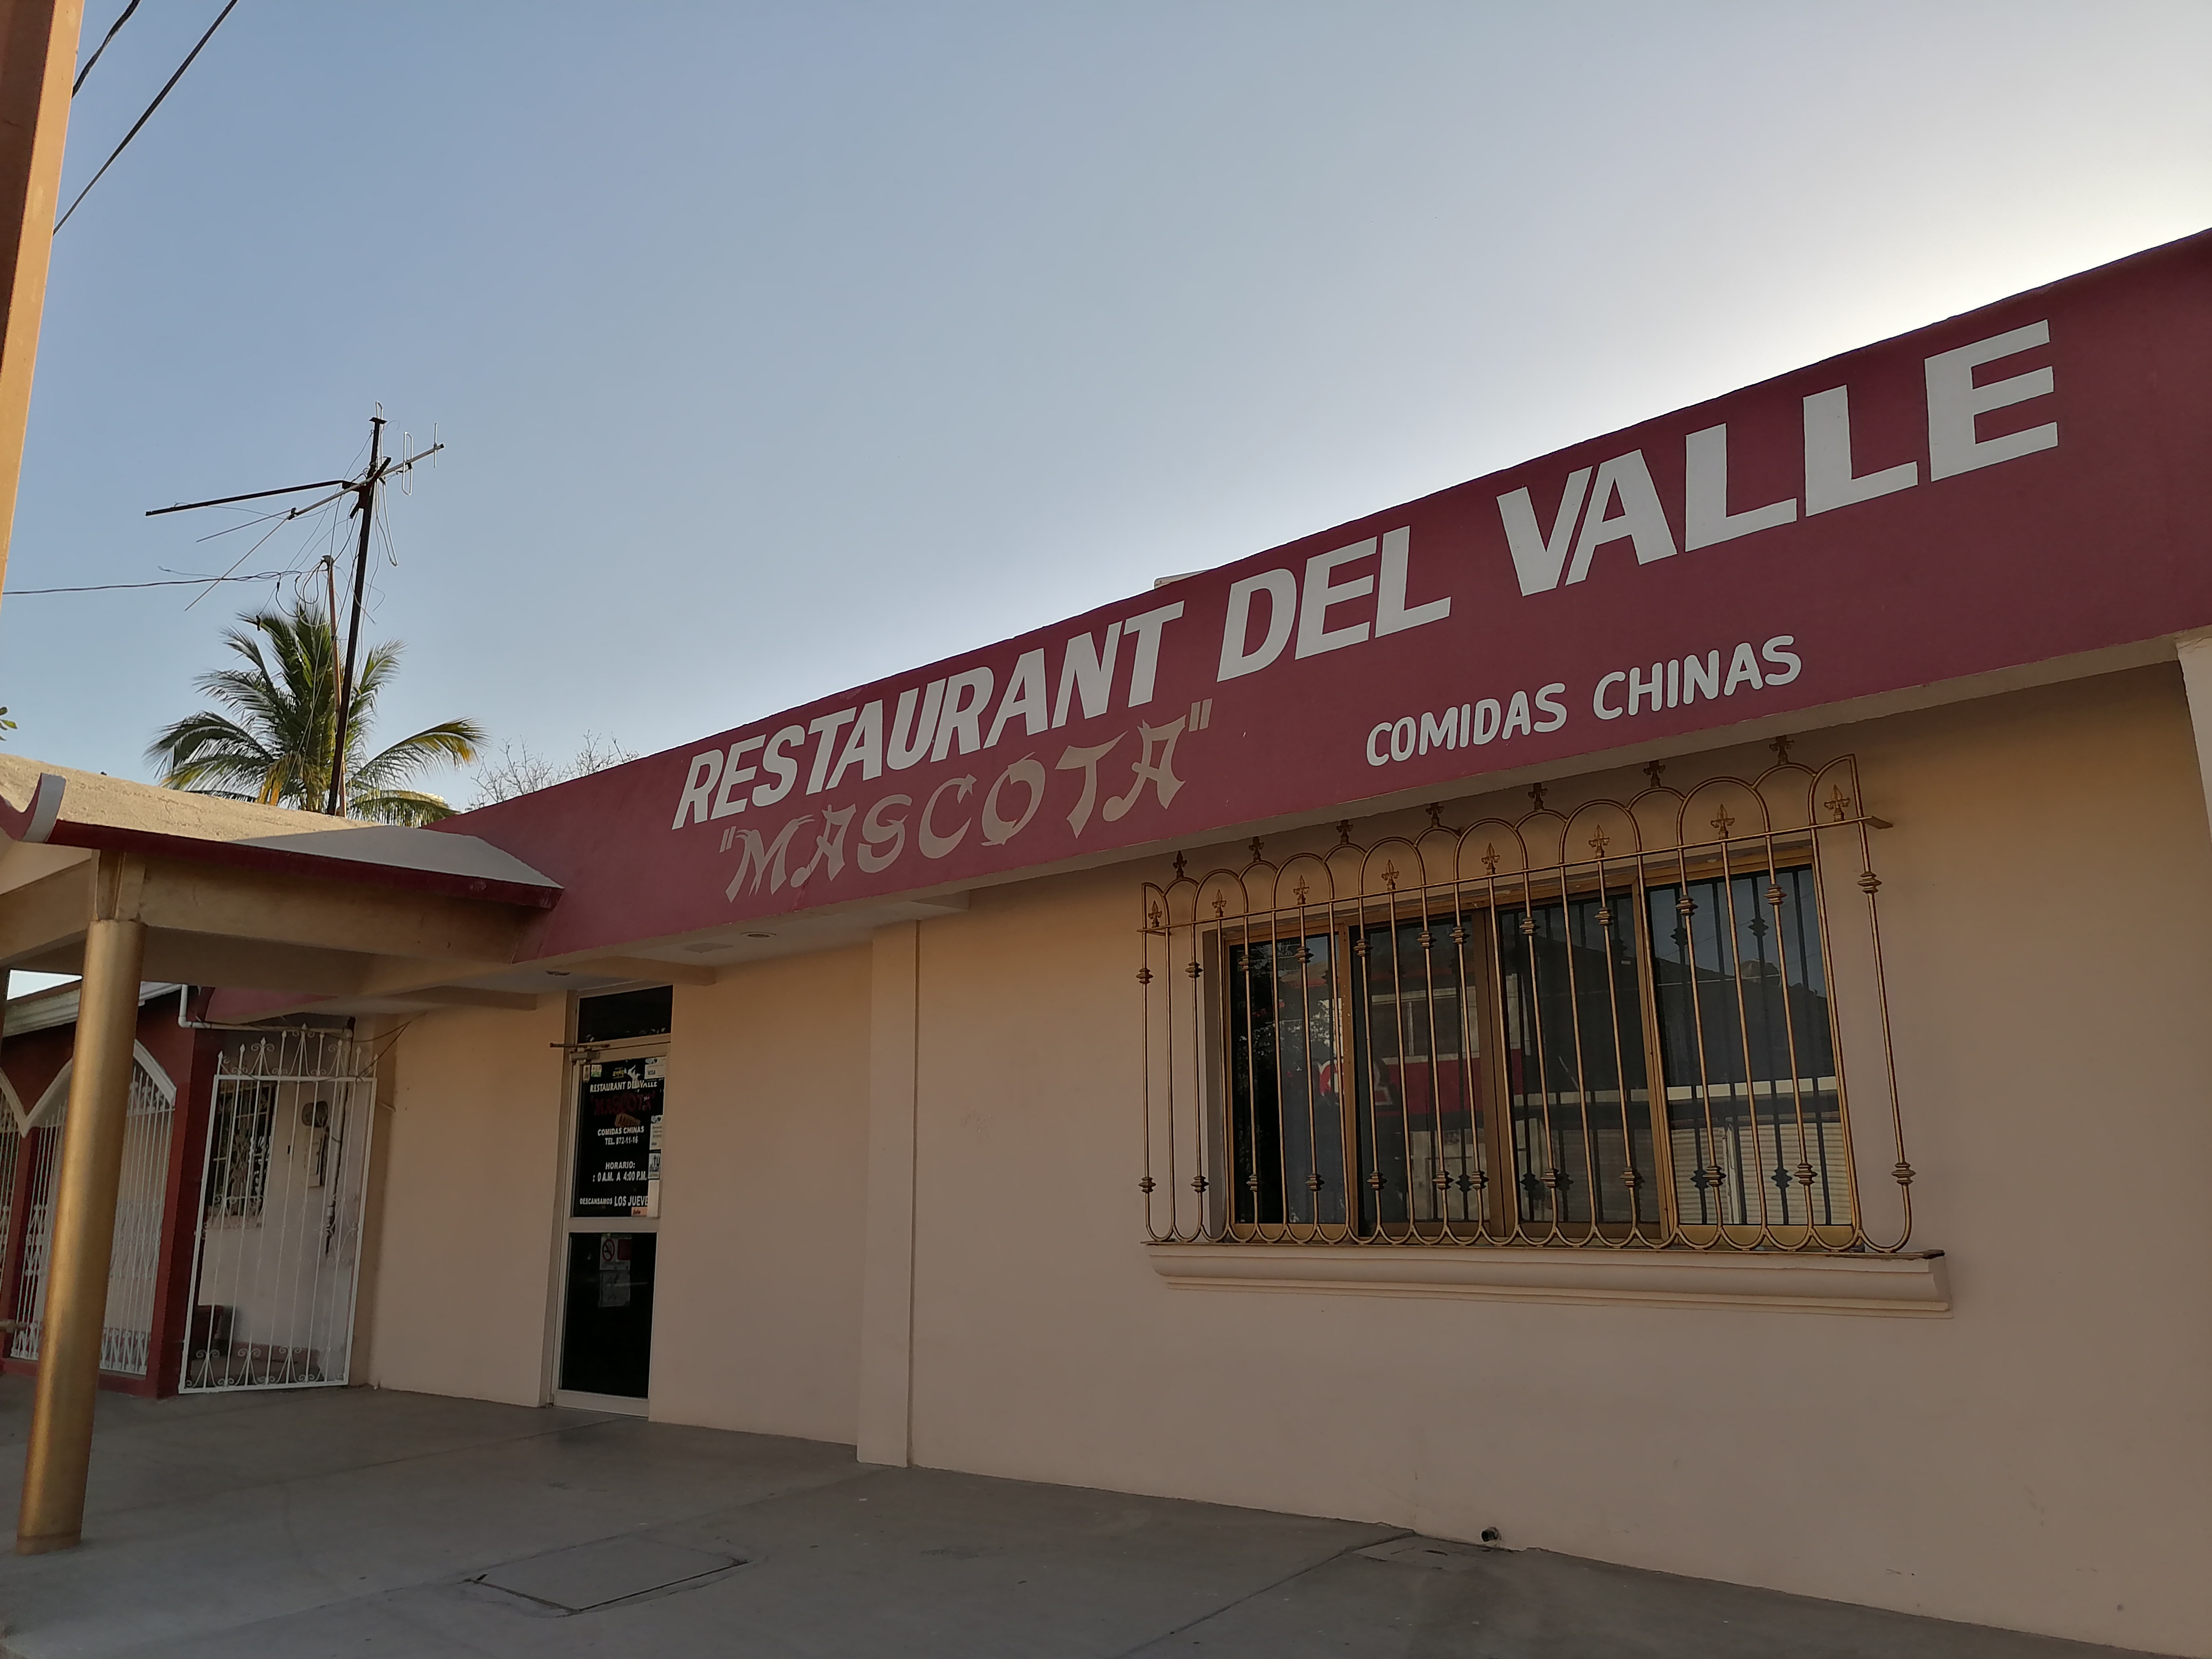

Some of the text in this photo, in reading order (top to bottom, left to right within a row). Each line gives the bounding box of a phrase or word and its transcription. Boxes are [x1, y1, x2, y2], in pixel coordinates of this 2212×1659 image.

[671, 319, 2059, 831] RESTAURANT DEL VALLE
[1365, 634, 1803, 767] COMIDAS CHINAS
[590, 1081, 626, 1093] RESTAURANT
[598, 1127, 622, 1136] COMIDAS
[623, 1126, 644, 1134] CHINAS
[606, 1161, 635, 1170] HORARIO:
[616, 1172, 620, 1181] A
[623, 1171, 635, 1181] 4:00
[614, 1196, 627, 1207] LOS
[628, 1195, 648, 1206] JUEVE
